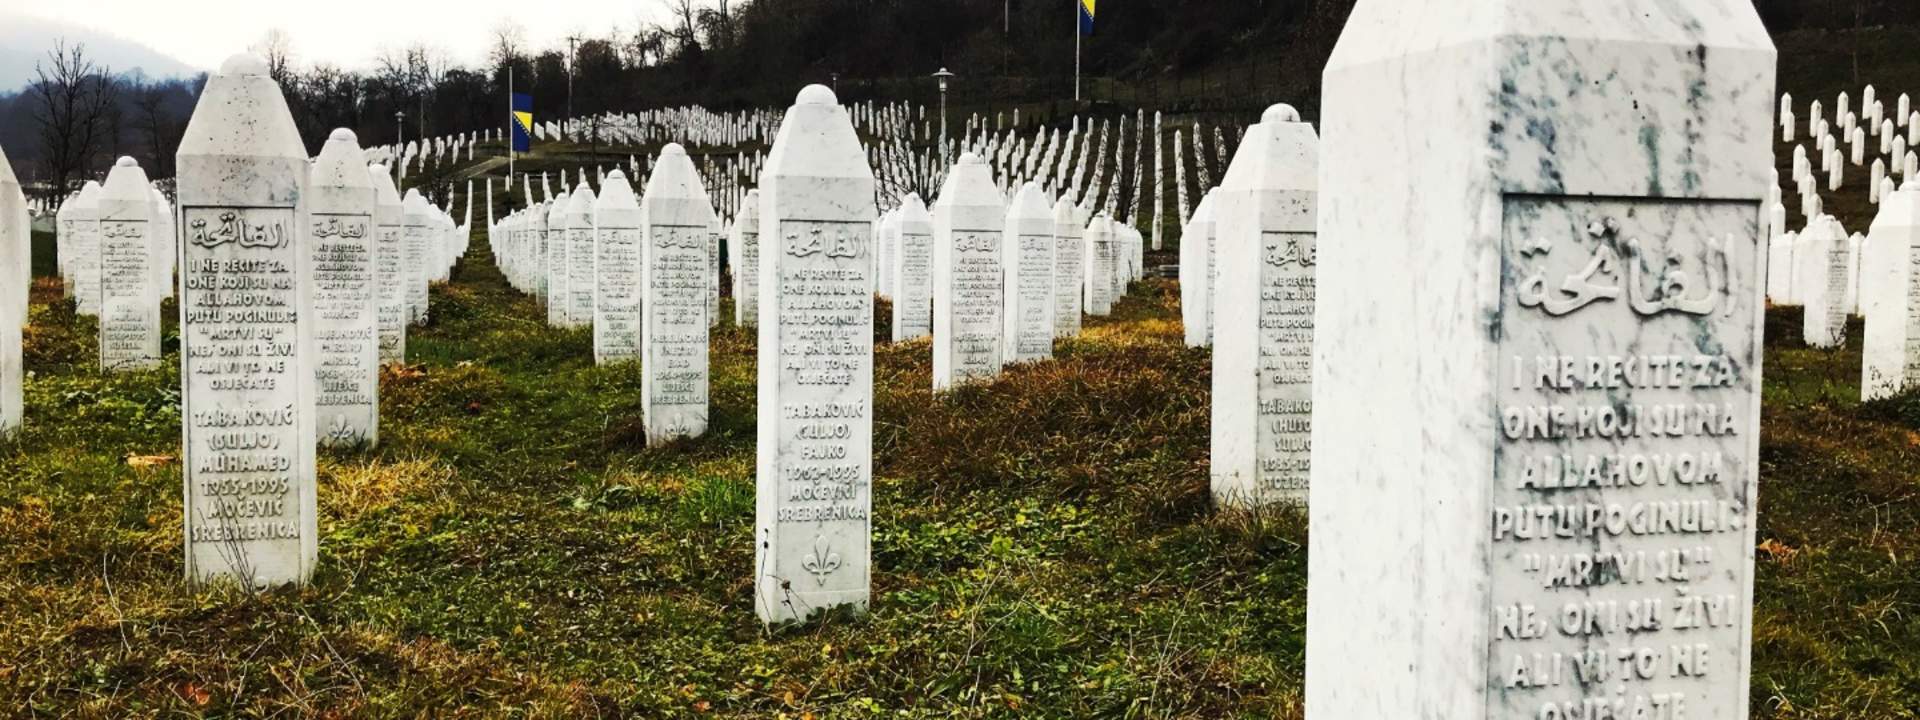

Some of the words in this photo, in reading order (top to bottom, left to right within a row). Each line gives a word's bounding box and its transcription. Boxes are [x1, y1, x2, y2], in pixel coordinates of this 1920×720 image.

[191, 260, 197, 273] I
[201, 260, 219, 273] NE
[224, 260, 266, 273] RECITE
[269, 260, 289, 273] ZA
[1517, 216, 1737, 318] الفاتحة
[188, 277, 215, 290] ONE
[220, 277, 249, 290] KOJI
[252, 277, 268, 290] SU
[273, 277, 292, 290] NA
[783, 284, 805, 296] ONE
[195, 294, 286, 308] ALLAHOVOM
[187, 311, 222, 324] PUTU
[219, 344, 245, 358] ONI
[247, 344, 262, 358] SU
[266, 341, 295, 358] ŽIVI
[225, 361, 240, 374] VI
[269, 361, 285, 374] NE
[1512, 355, 1523, 390] I
[1535, 355, 1574, 391] NE
[1585, 354, 1684, 389] RECITE
[1692, 354, 1736, 389] ZA
[195, 404, 293, 427] TABAKOVIĆ
[784, 399, 864, 419] TABAKOVIĆ
[1260, 399, 1312, 414] TABAKO
[1502, 405, 1569, 441] ONE
[1576, 404, 1643, 440] KOJI
[1651, 404, 1686, 437] SU
[1695, 403, 1739, 437] NA
[208, 431, 279, 450] (SULJO)
[800, 444, 846, 460] FAJKO
[199, 455, 291, 473] MUHAMED
[1517, 452, 1723, 490] ALLAHOVOM
[201, 477, 289, 496] 1955-1995
[778, 505, 867, 522] SREBRENICA
[1493, 505, 1575, 541] PUTU
[1585, 500, 1745, 537] POGINULI:
[192, 521, 299, 542] SREBRENICA
[1494, 602, 1547, 640] NE,
[1560, 600, 1617, 636] ONI
[1626, 598, 1662, 632] SU
[1672, 585, 1736, 630] ŽIVI
[1506, 652, 1562, 687] ALI
[1573, 650, 1609, 683] VI
[1617, 647, 1660, 680] TO
[1670, 643, 1709, 678] NE
